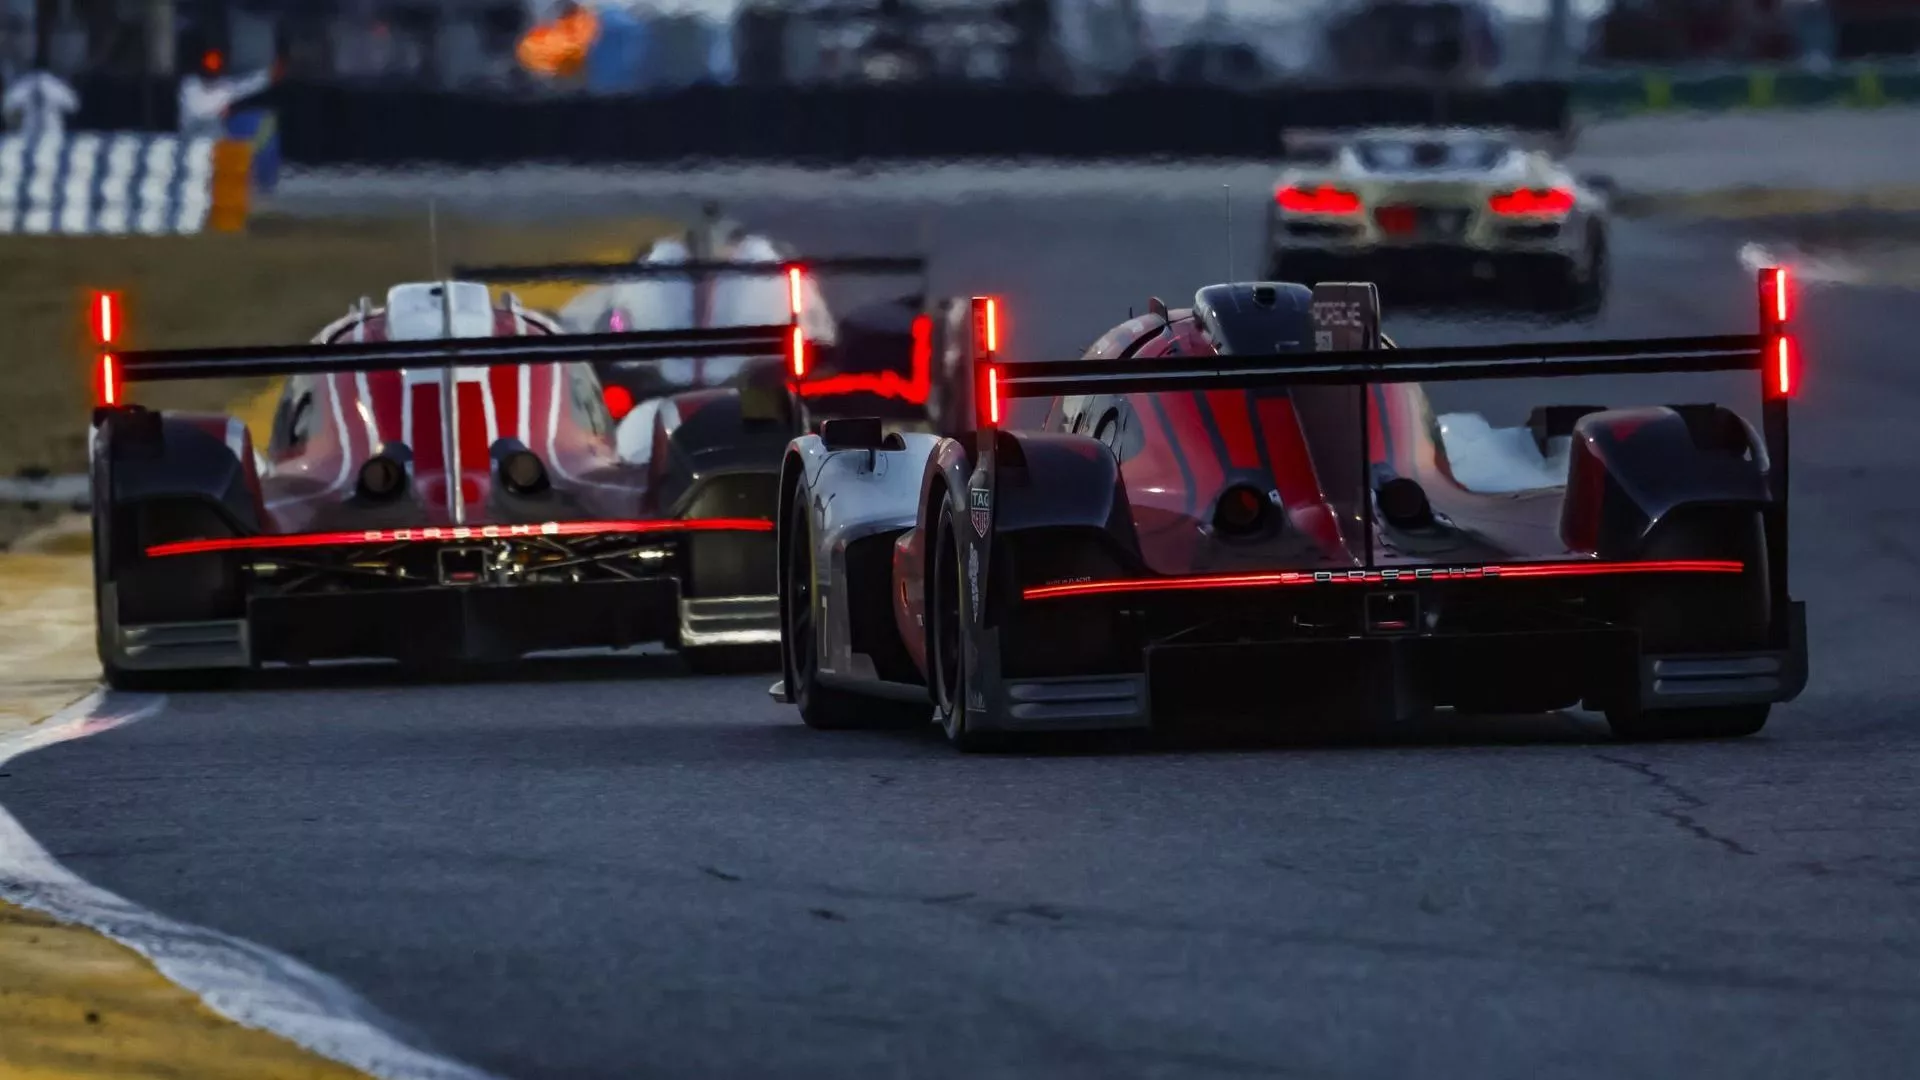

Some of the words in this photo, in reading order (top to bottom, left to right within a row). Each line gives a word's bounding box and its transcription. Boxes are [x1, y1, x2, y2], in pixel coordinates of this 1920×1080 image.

[972, 492, 989, 507] TAG
[364, 521, 559, 541] PORSCHE
[1280, 565, 1500, 584] PORSCHE
